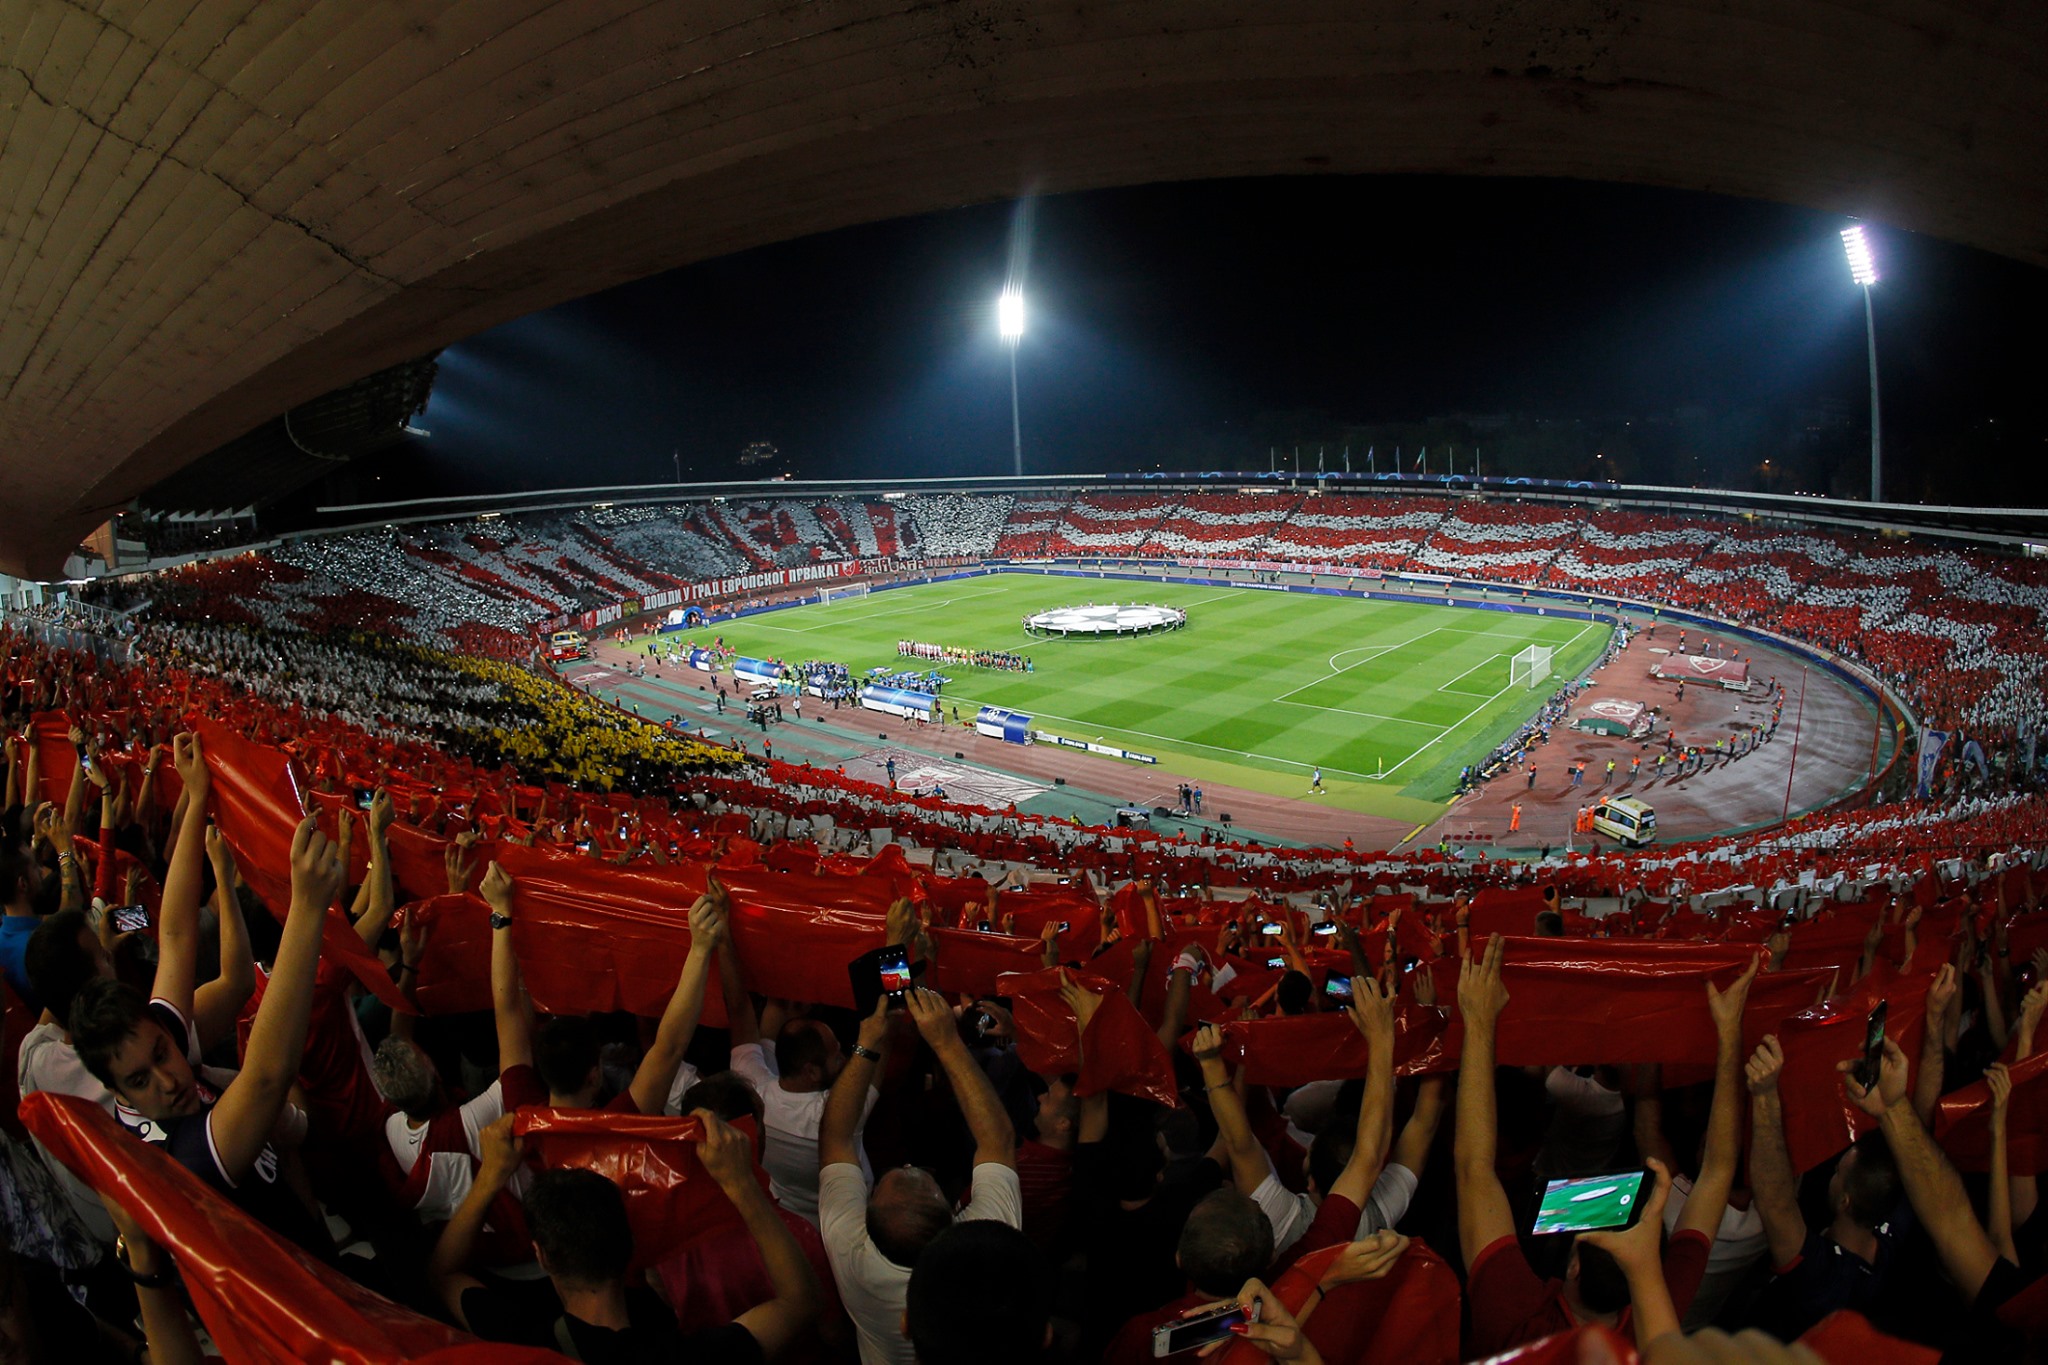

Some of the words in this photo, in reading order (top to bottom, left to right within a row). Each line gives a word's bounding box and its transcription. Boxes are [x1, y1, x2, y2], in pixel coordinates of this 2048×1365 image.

[595, 603, 622, 627] ДОБРО
[643, 588, 683, 611] ДОШЛИ
[683, 586, 691, 602] У
[692, 580, 720, 600] ГРАД
[722, 569, 786, 594] ЕВРОПСКОГ
[788, 563, 839, 583] ПРВАКА!
